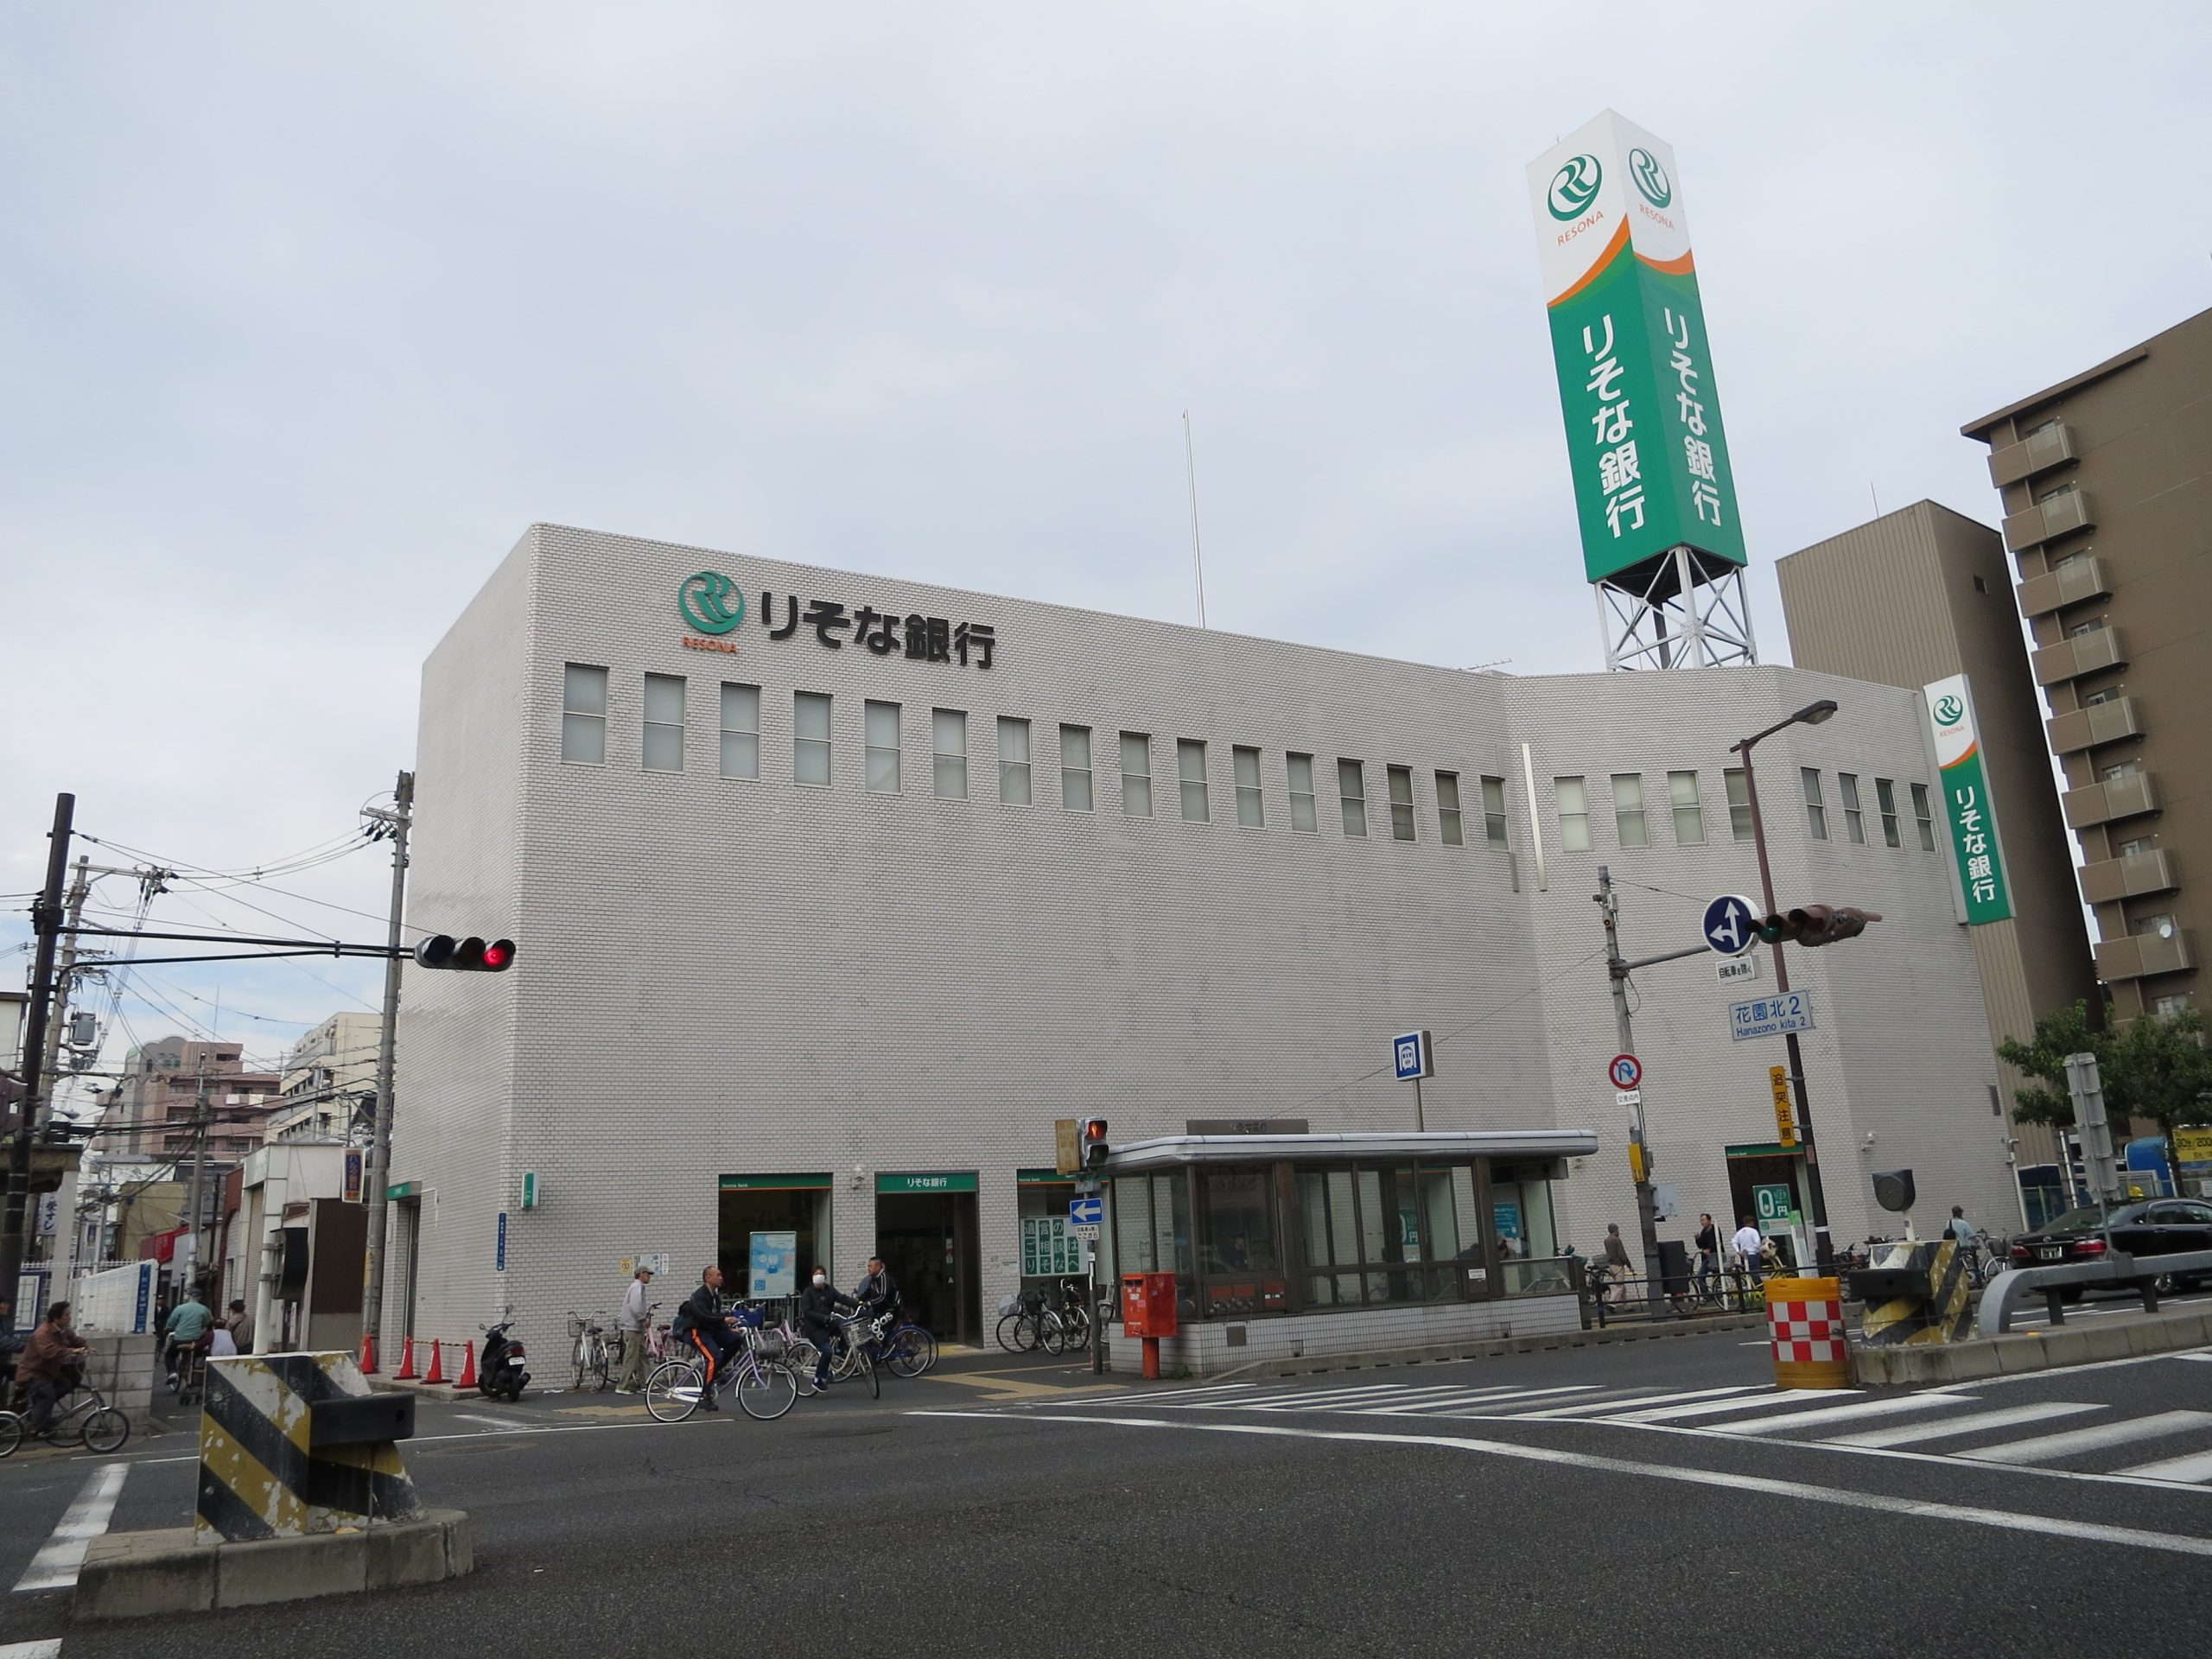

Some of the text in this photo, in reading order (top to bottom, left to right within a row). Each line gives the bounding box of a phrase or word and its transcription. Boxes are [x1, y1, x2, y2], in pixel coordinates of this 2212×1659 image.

[1557, 210, 1605, 247] RESONA
[1639, 203, 1675, 232] RESONA
[1582, 313, 1645, 539] りそな銀行
[1663, 307, 1721, 527] りそな銀行
[760, 591, 996, 669] りそな銀行
[682, 635, 740, 655] RESONA
[1939, 724, 1966, 738] RESONA
[1955, 785, 1996, 904] りそな銀行
[1736, 1016, 1807, 1038] Hanazono kita 2
[907, 1177, 948, 1188] りそな銀行
[1027, 1258, 1078, 1272] りそなへ
